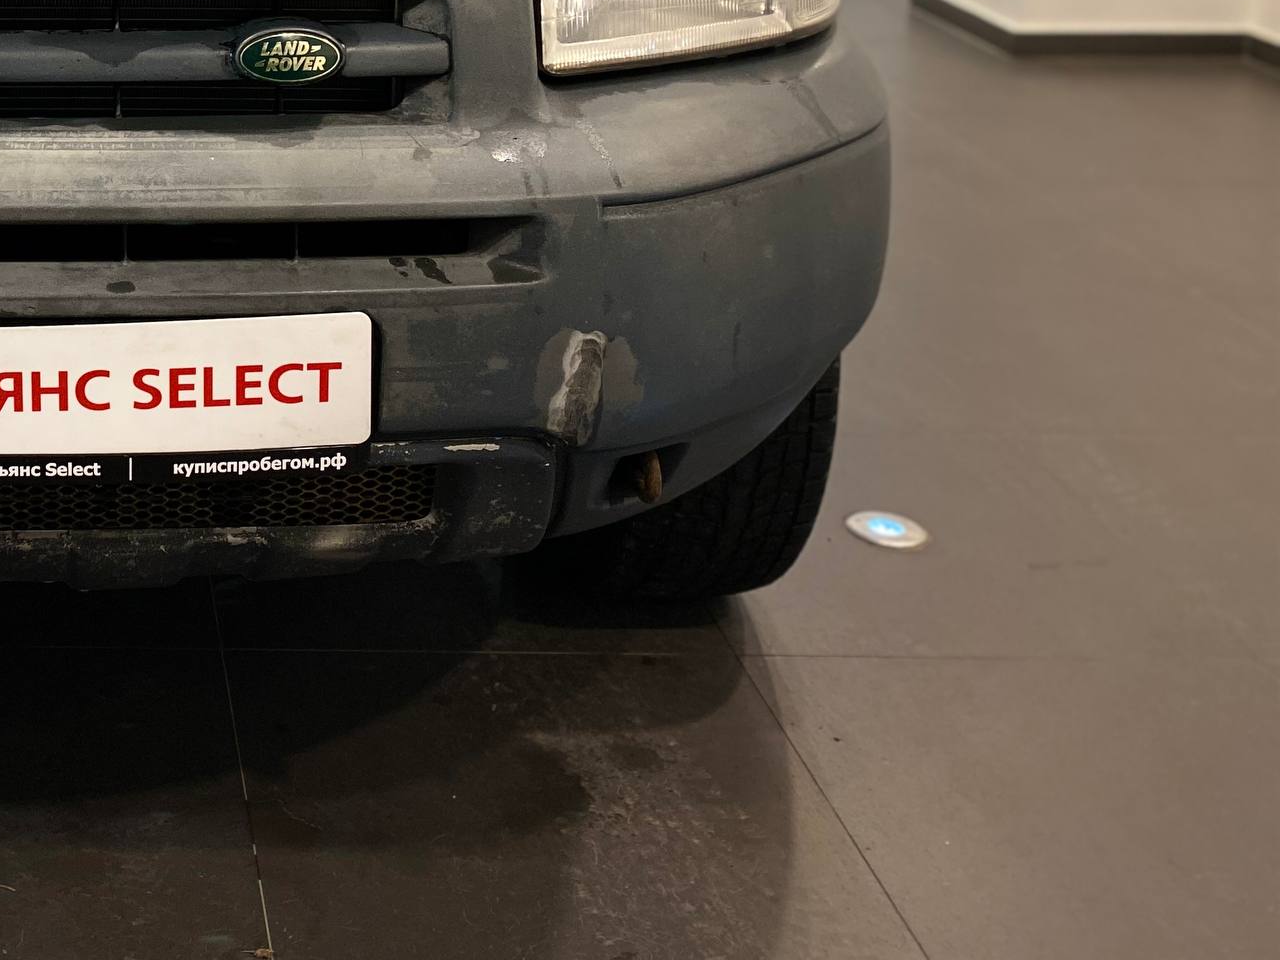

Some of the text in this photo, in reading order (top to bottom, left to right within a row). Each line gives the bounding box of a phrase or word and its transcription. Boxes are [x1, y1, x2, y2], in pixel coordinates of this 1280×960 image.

[260, 40, 310, 57] LAND
[265, 56, 327, 72] ROVER
[133, 362, 344, 411] SELECT
[45, 461, 102, 478] Select
[172, 452, 348, 478] куписпробегом.рф
